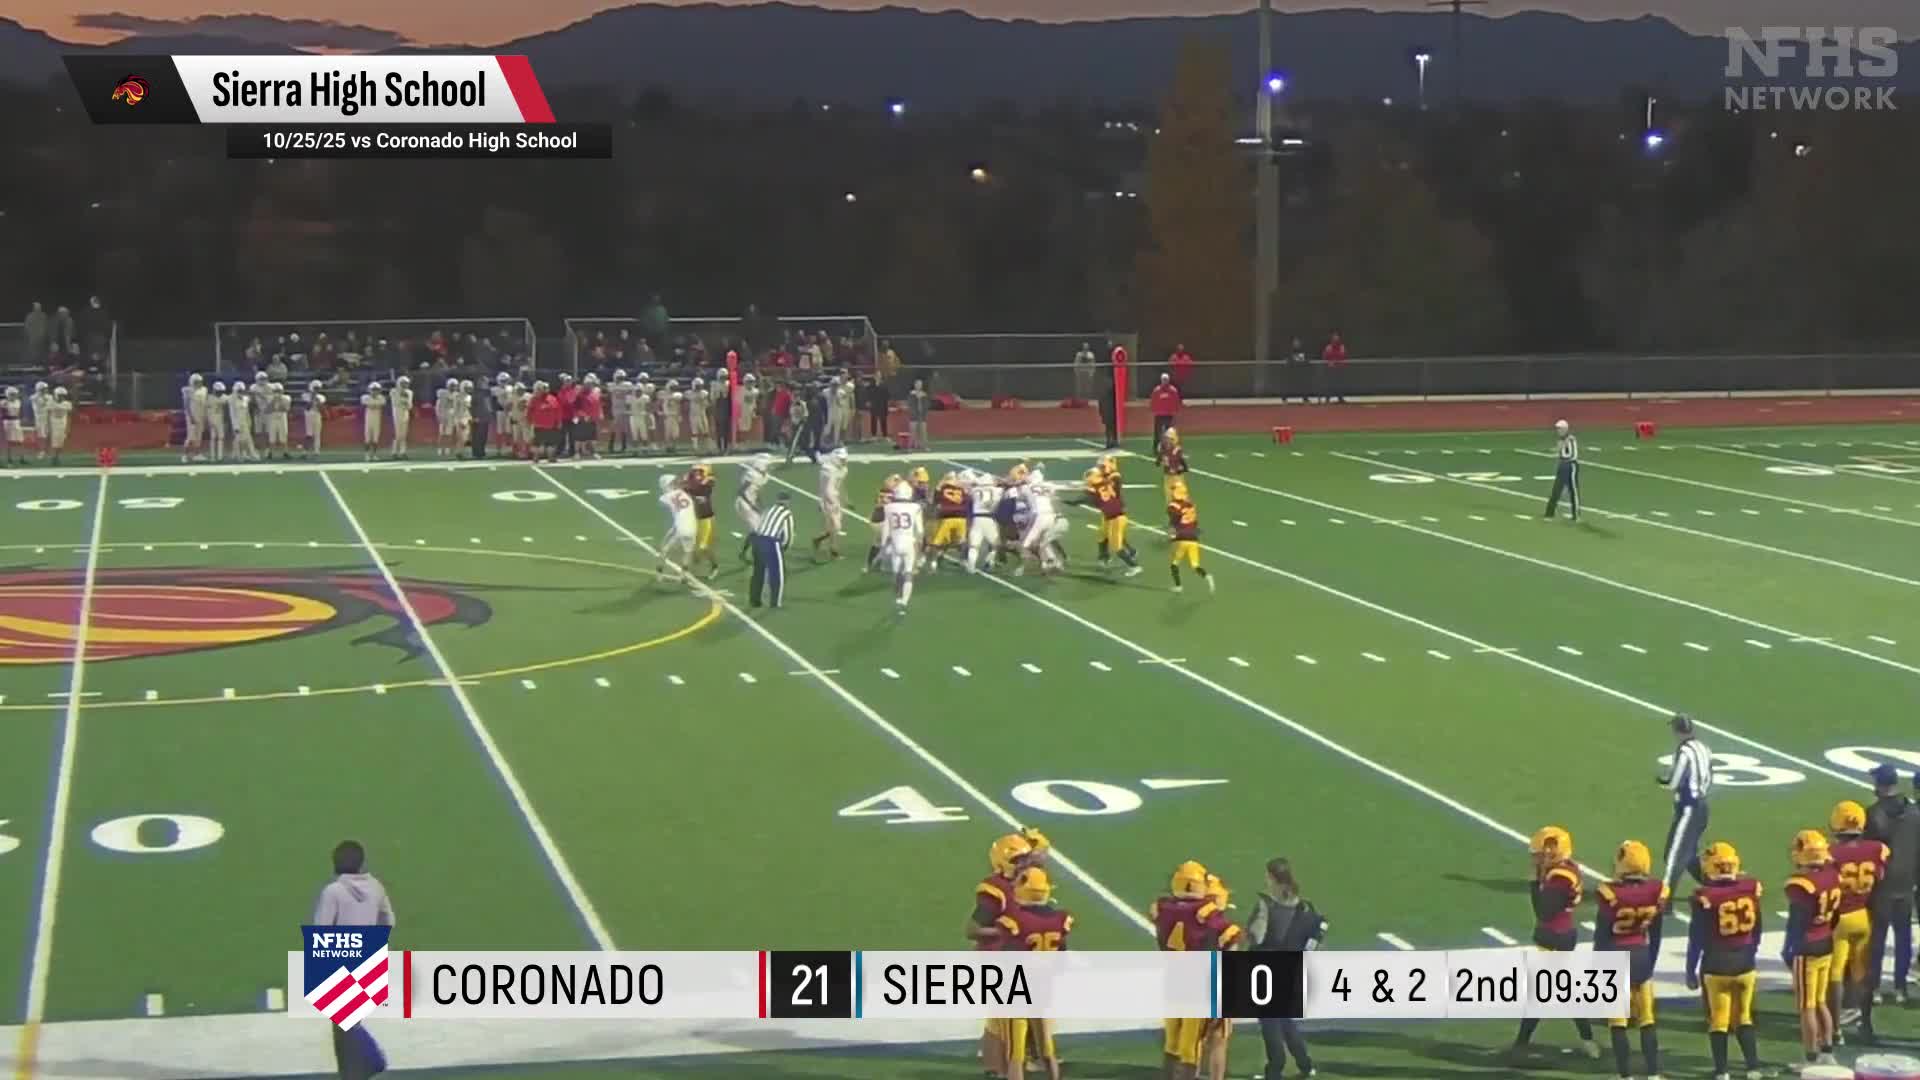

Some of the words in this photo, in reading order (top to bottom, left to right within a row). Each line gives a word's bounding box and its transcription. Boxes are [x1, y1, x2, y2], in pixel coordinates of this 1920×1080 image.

[891, 512, 912, 530] 33
[1613, 906, 1657, 934] 27
[1717, 896, 1756, 937] 63
